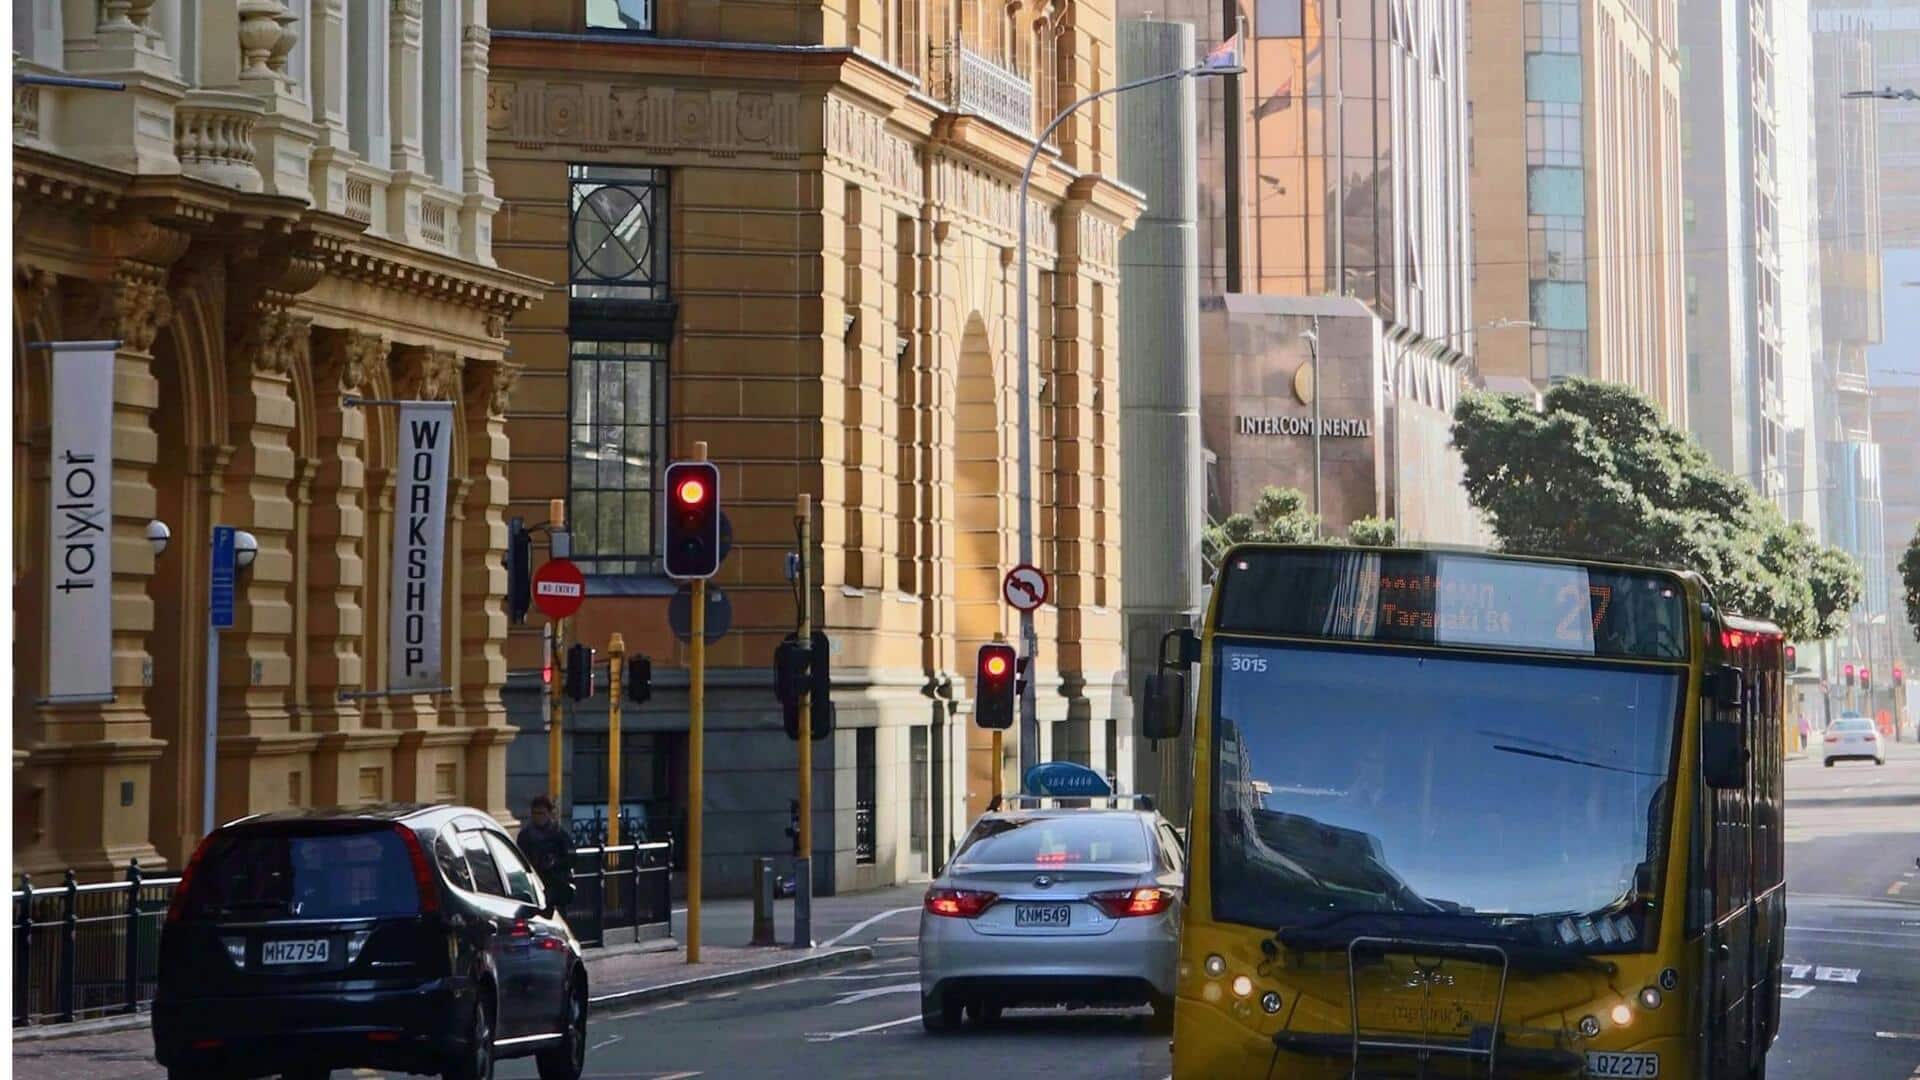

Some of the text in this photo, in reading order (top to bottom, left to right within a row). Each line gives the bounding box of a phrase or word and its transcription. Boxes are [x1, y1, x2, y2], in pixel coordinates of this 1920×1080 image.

[56, 449, 104, 594] taylor
[405, 420, 440, 677] WORKSHOP
[1555, 584, 1611, 637] 27
[1231, 657, 1267, 672] 3015
[1018, 908, 1067, 922] KNM549
[264, 942, 326, 961] MHZ794
